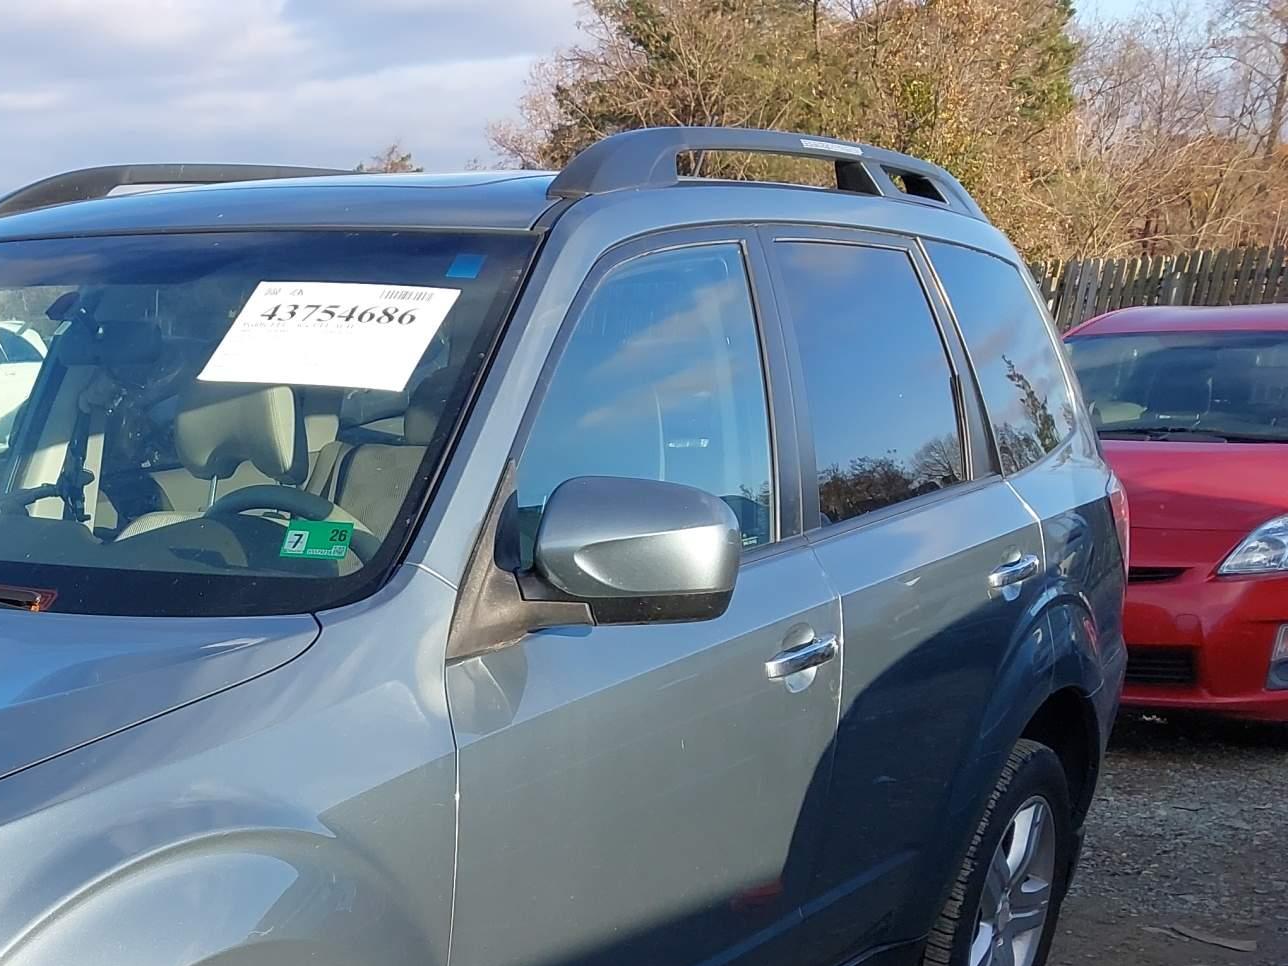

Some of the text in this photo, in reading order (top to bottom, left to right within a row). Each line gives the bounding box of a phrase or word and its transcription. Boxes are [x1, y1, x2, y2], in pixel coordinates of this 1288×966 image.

[260, 304, 418, 325] 43754686
[292, 529, 348, 549] 7 26
